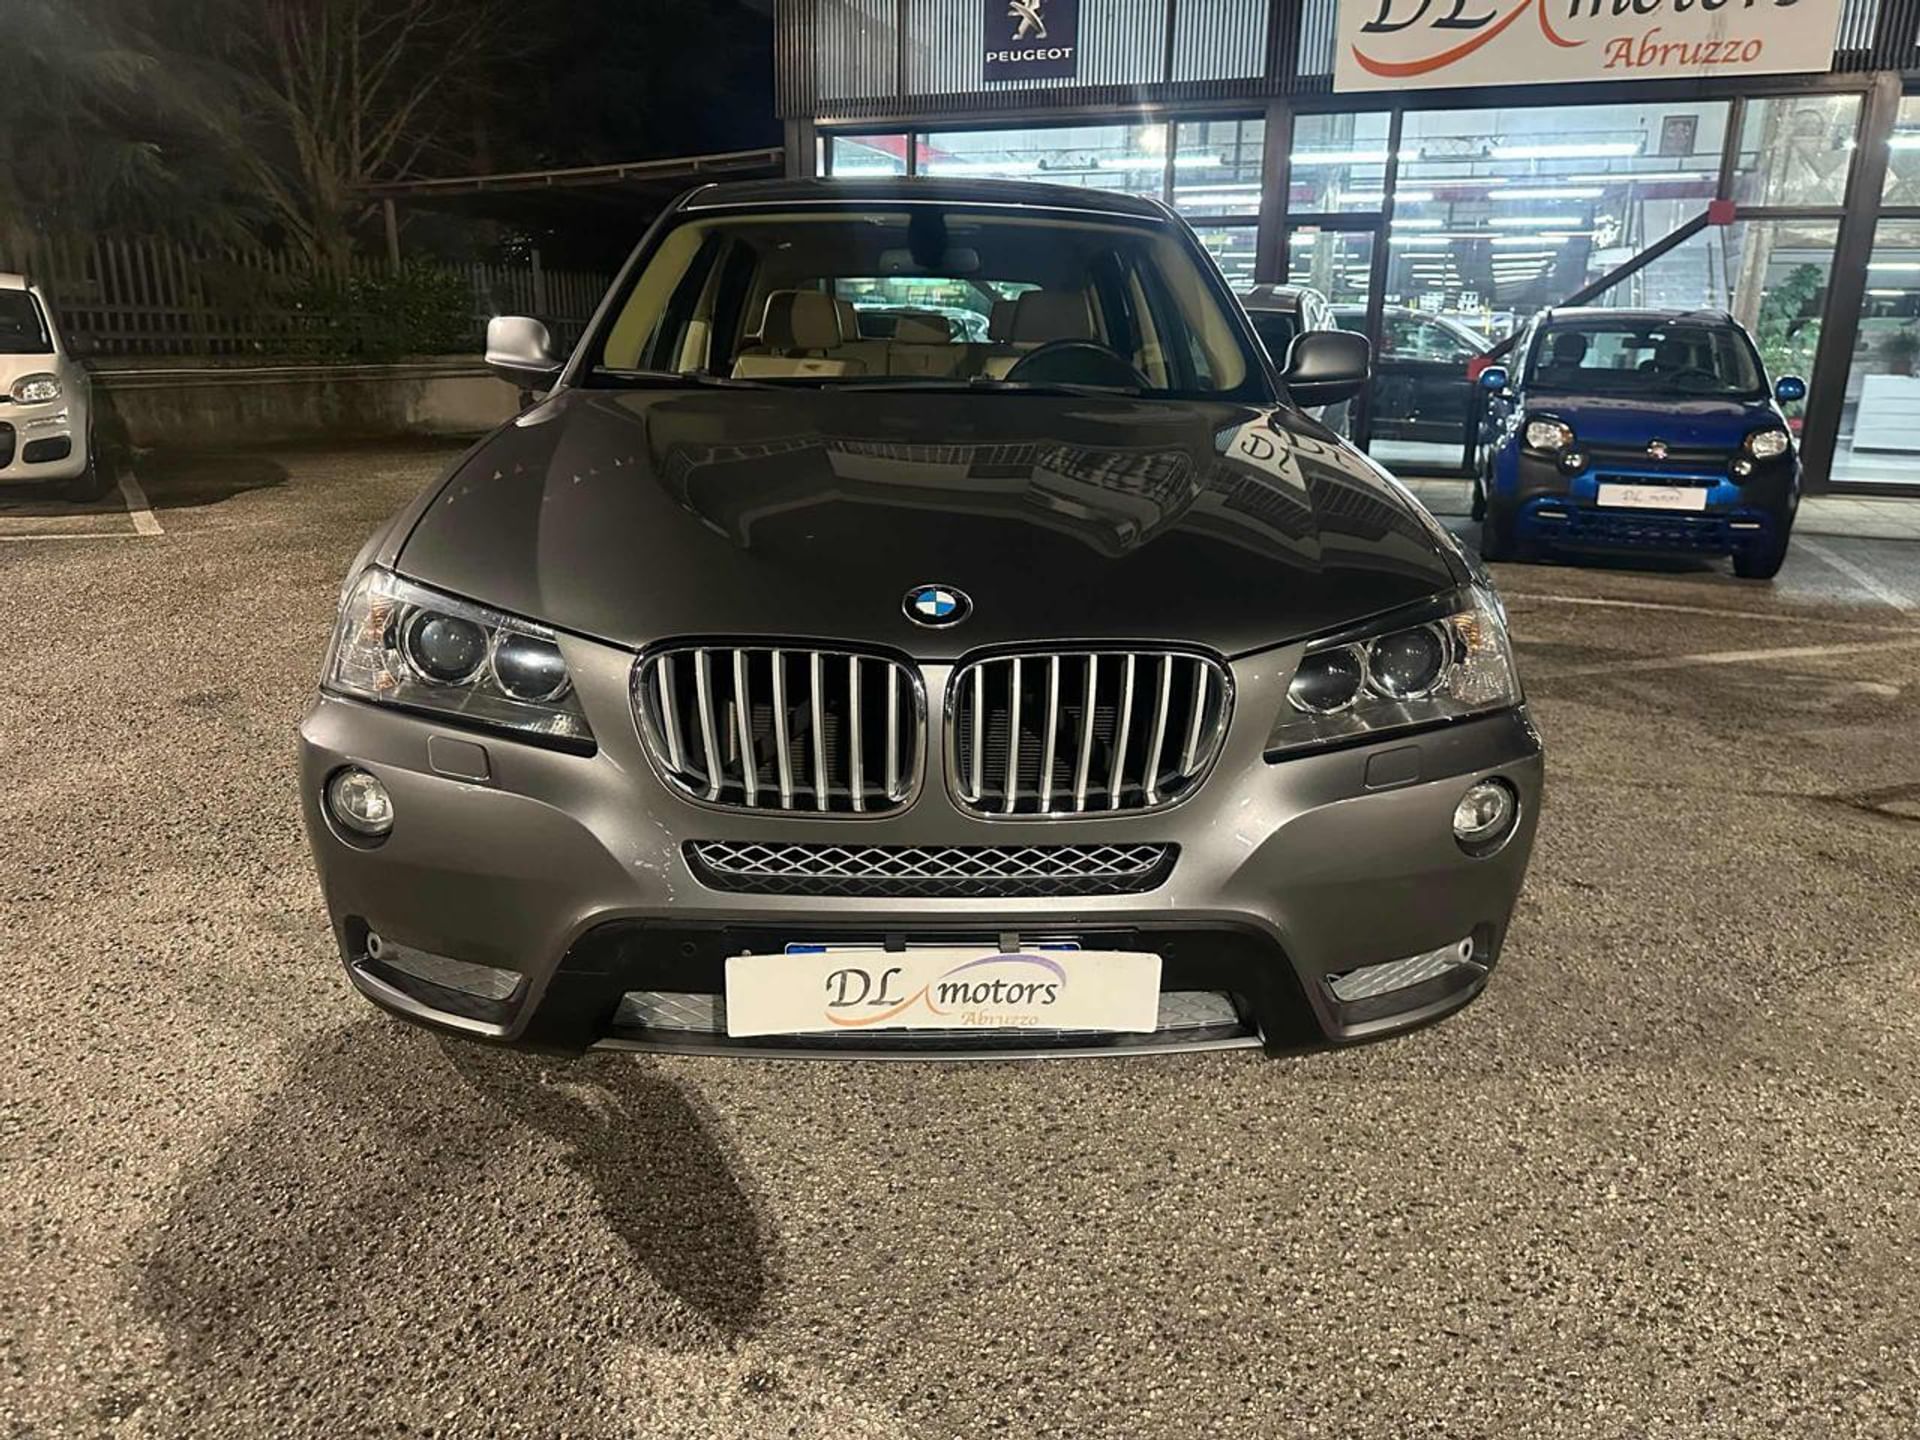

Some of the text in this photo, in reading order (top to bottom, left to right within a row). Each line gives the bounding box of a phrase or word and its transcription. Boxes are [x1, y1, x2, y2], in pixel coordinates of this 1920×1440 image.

[986, 48, 1073, 63] PEUGEOT
[1604, 28, 1762, 68] Abruzzo
[826, 967, 1058, 1007] DL motors
